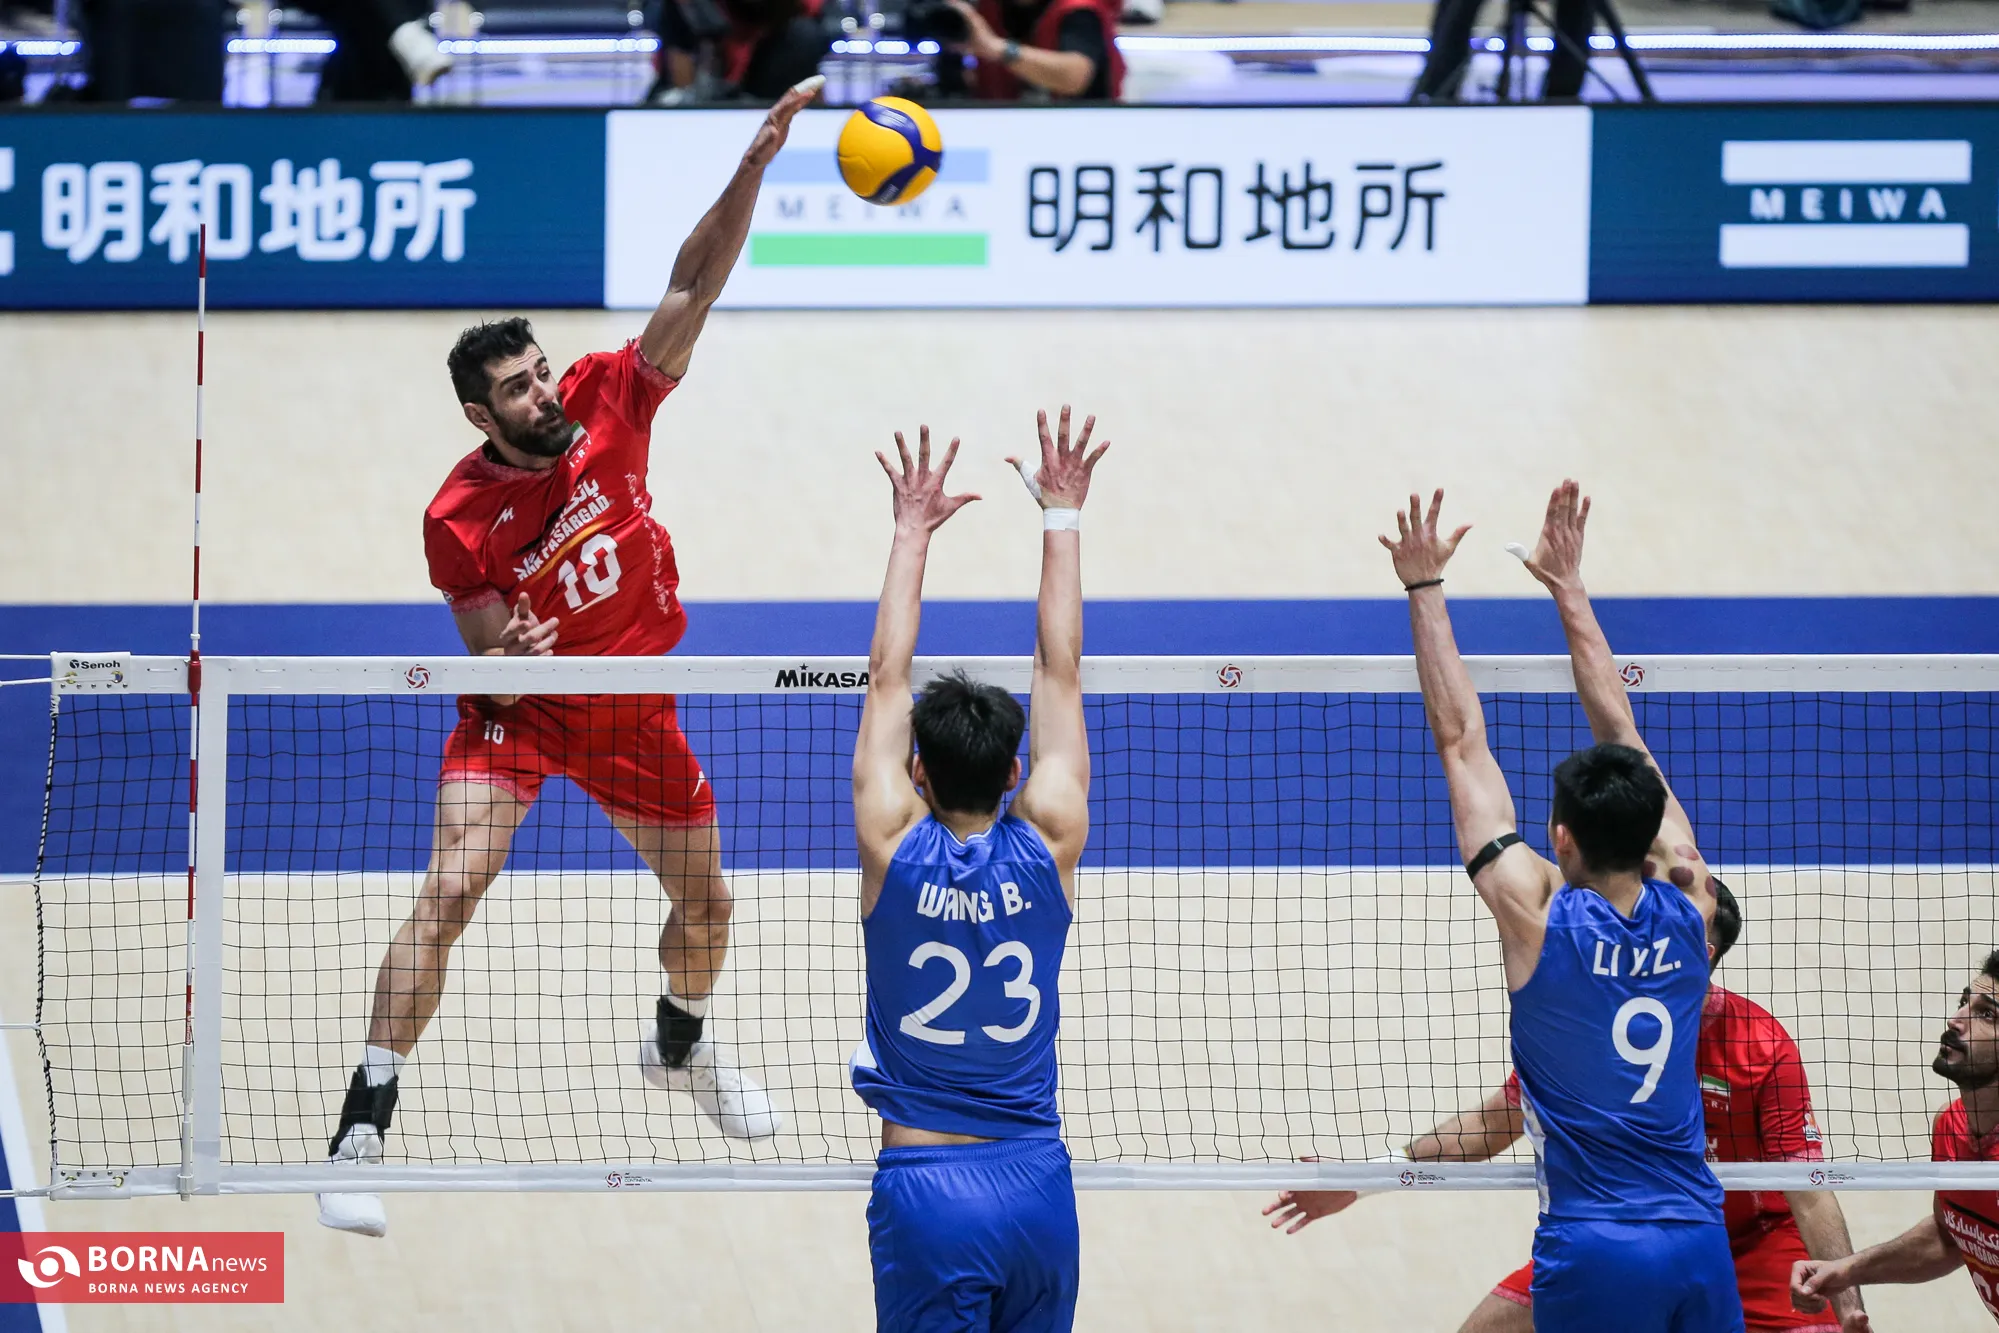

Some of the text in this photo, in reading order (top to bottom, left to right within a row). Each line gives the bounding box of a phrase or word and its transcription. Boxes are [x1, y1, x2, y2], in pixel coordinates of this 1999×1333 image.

[42, 158, 476, 262] 明和地所
[1027, 160, 1447, 253] 明和地所
[1750, 187, 1946, 220] MEIWA
[557, 533, 622, 610] 10
[81, 660, 121, 670] Senoh
[484, 720, 504, 745] 10
[916, 881, 1032, 924] WANG B.
[1593, 940, 1621, 977] LI
[899, 940, 1041, 1045] 23
[1612, 996, 1673, 1104] 9
